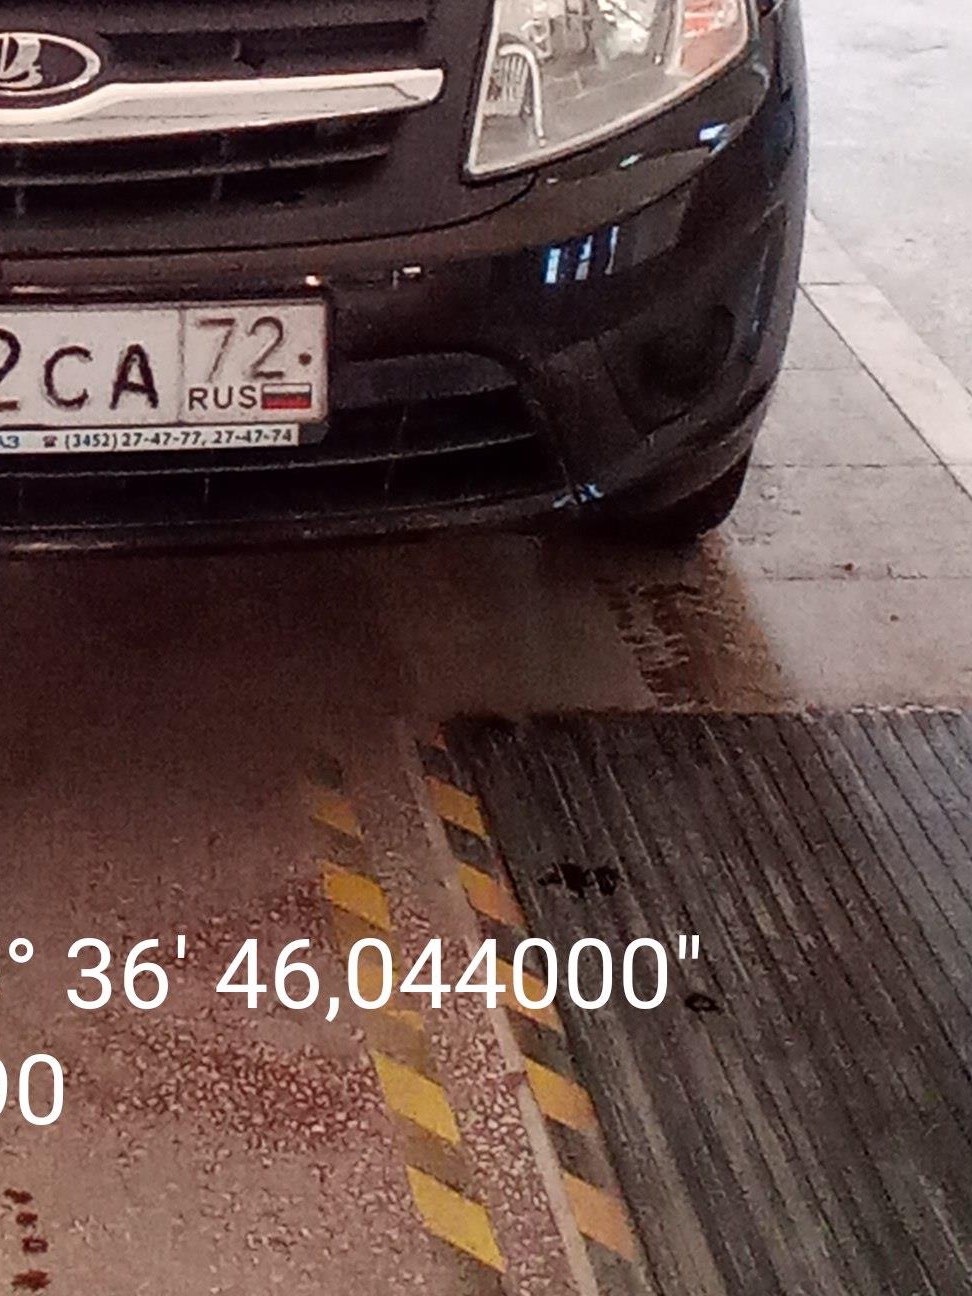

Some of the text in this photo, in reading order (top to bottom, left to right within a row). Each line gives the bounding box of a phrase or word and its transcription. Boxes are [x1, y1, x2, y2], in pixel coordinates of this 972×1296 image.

[196, 316, 285, 381] 72
[188, 385, 258, 411] RUS
[214, 429, 293, 446] 27-47-74
